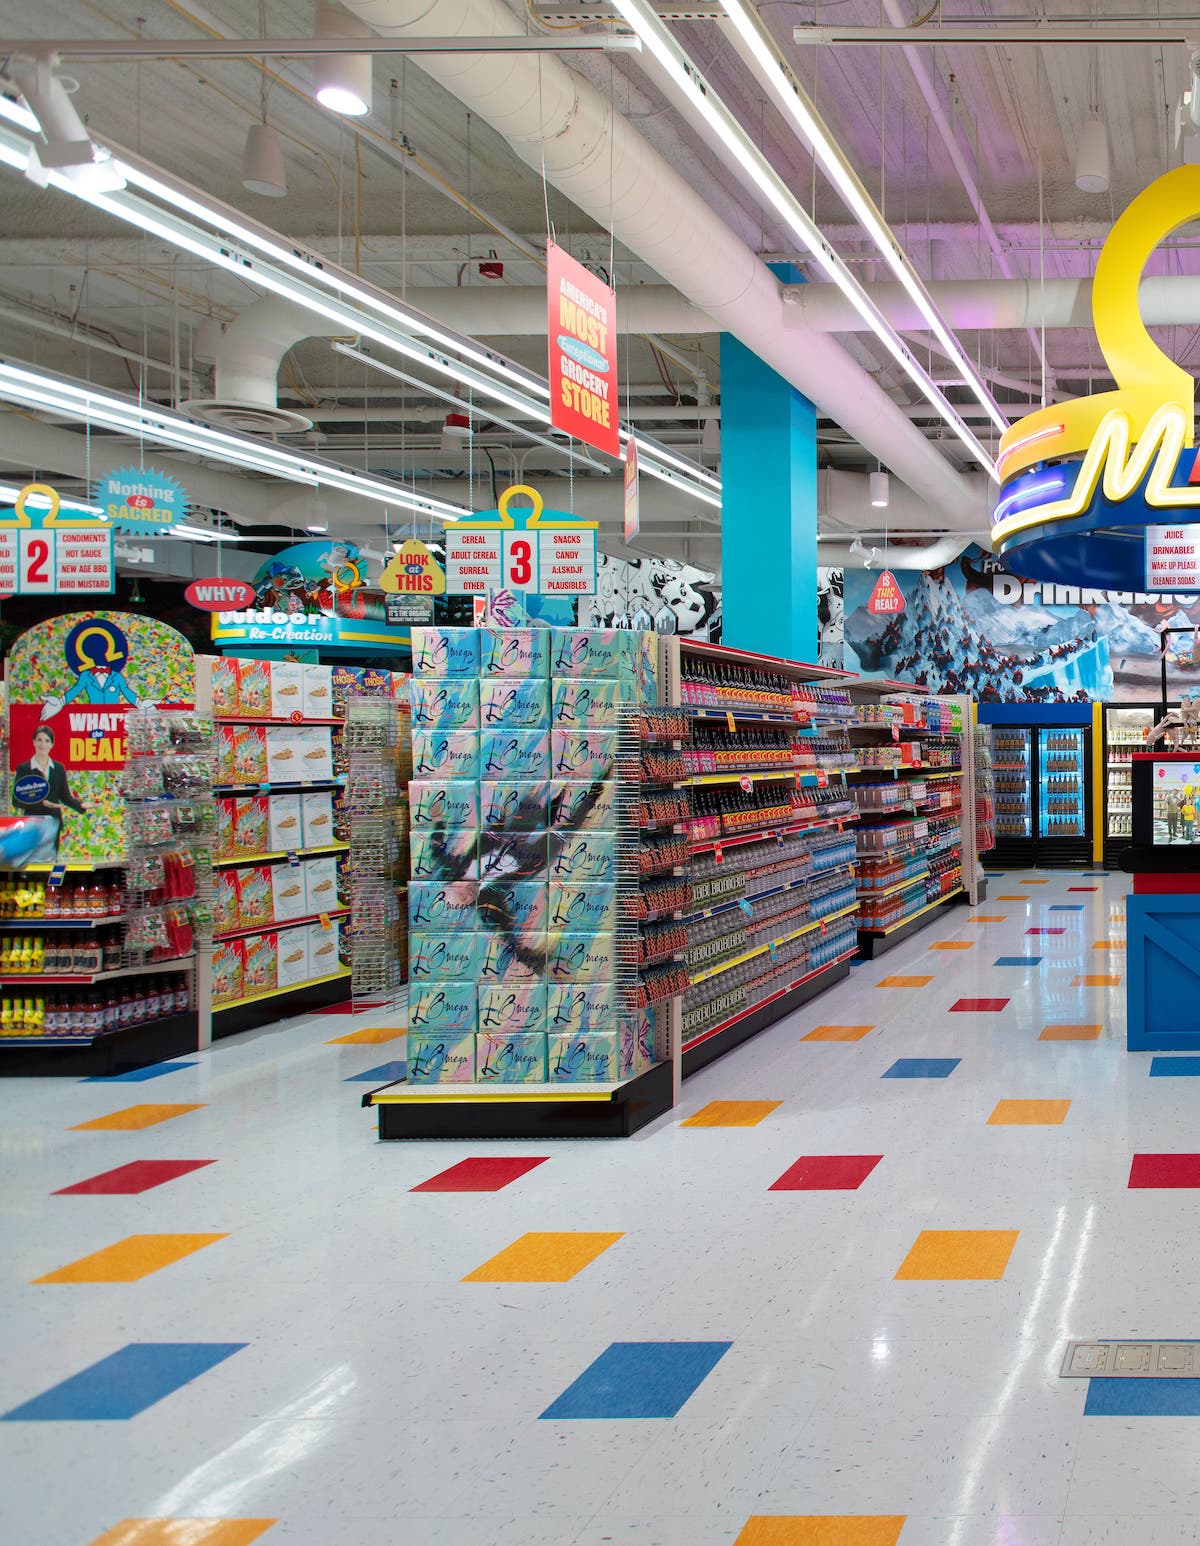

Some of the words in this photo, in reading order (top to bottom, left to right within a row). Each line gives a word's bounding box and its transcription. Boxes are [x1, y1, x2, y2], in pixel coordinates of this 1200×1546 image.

[560, 278, 607, 325] AMERICA'S
[560, 295, 607, 355] MOST
[560, 356, 608, 400] GROCERY
[561, 377, 611, 429] STORE
[108, 480, 174, 503] Nothing
[134, 495, 148, 508] is
[107, 503, 173, 523] SACRED
[62, 534, 106, 543] CONDIMENTS
[462, 536, 486, 544] CEREAL
[553, 536, 581, 544] SNACKS
[1164, 530, 1184, 539] JUICE
[66, 549, 78, 558] HOT
[81, 549, 102, 558] SAUCE
[451, 552, 471, 560] ADULT
[473, 551, 498, 560] CEREAL
[555, 551, 579, 559] CANDY
[1153, 546, 1194, 555] DRINKABLES
[28, 540, 48, 582] 2
[400, 554, 429, 565] LOOK
[510, 541, 532, 584] 3
[62, 565, 76, 573] NEW
[79, 565, 91, 573] AGE
[94, 565, 107, 573] BBQ
[408, 565, 421, 574] at
[459, 566, 489, 575] SURREAL
[1152, 561, 1167, 570] WAKE
[1169, 561, 1176, 570] UP
[1178, 561, 1196, 570] PLEASE
[60, 580, 76, 588] BIRD
[78, 580, 110, 588] MUSTARD
[396, 575, 432, 591] THIS
[464, 582, 485, 590] OTHER
[548, 582, 587, 590] PLAUSIBLES
[882, 575, 890, 587] IS
[1153, 577, 1176, 585] CLEANER
[1178, 577, 1195, 585] SODAS
[195, 586, 247, 602] WHY?
[877, 587, 895, 598] THIS
[874, 598, 899, 610] REAL?
[218, 607, 321, 625] Outdoor
[249, 628, 332, 642] Re-Creation
